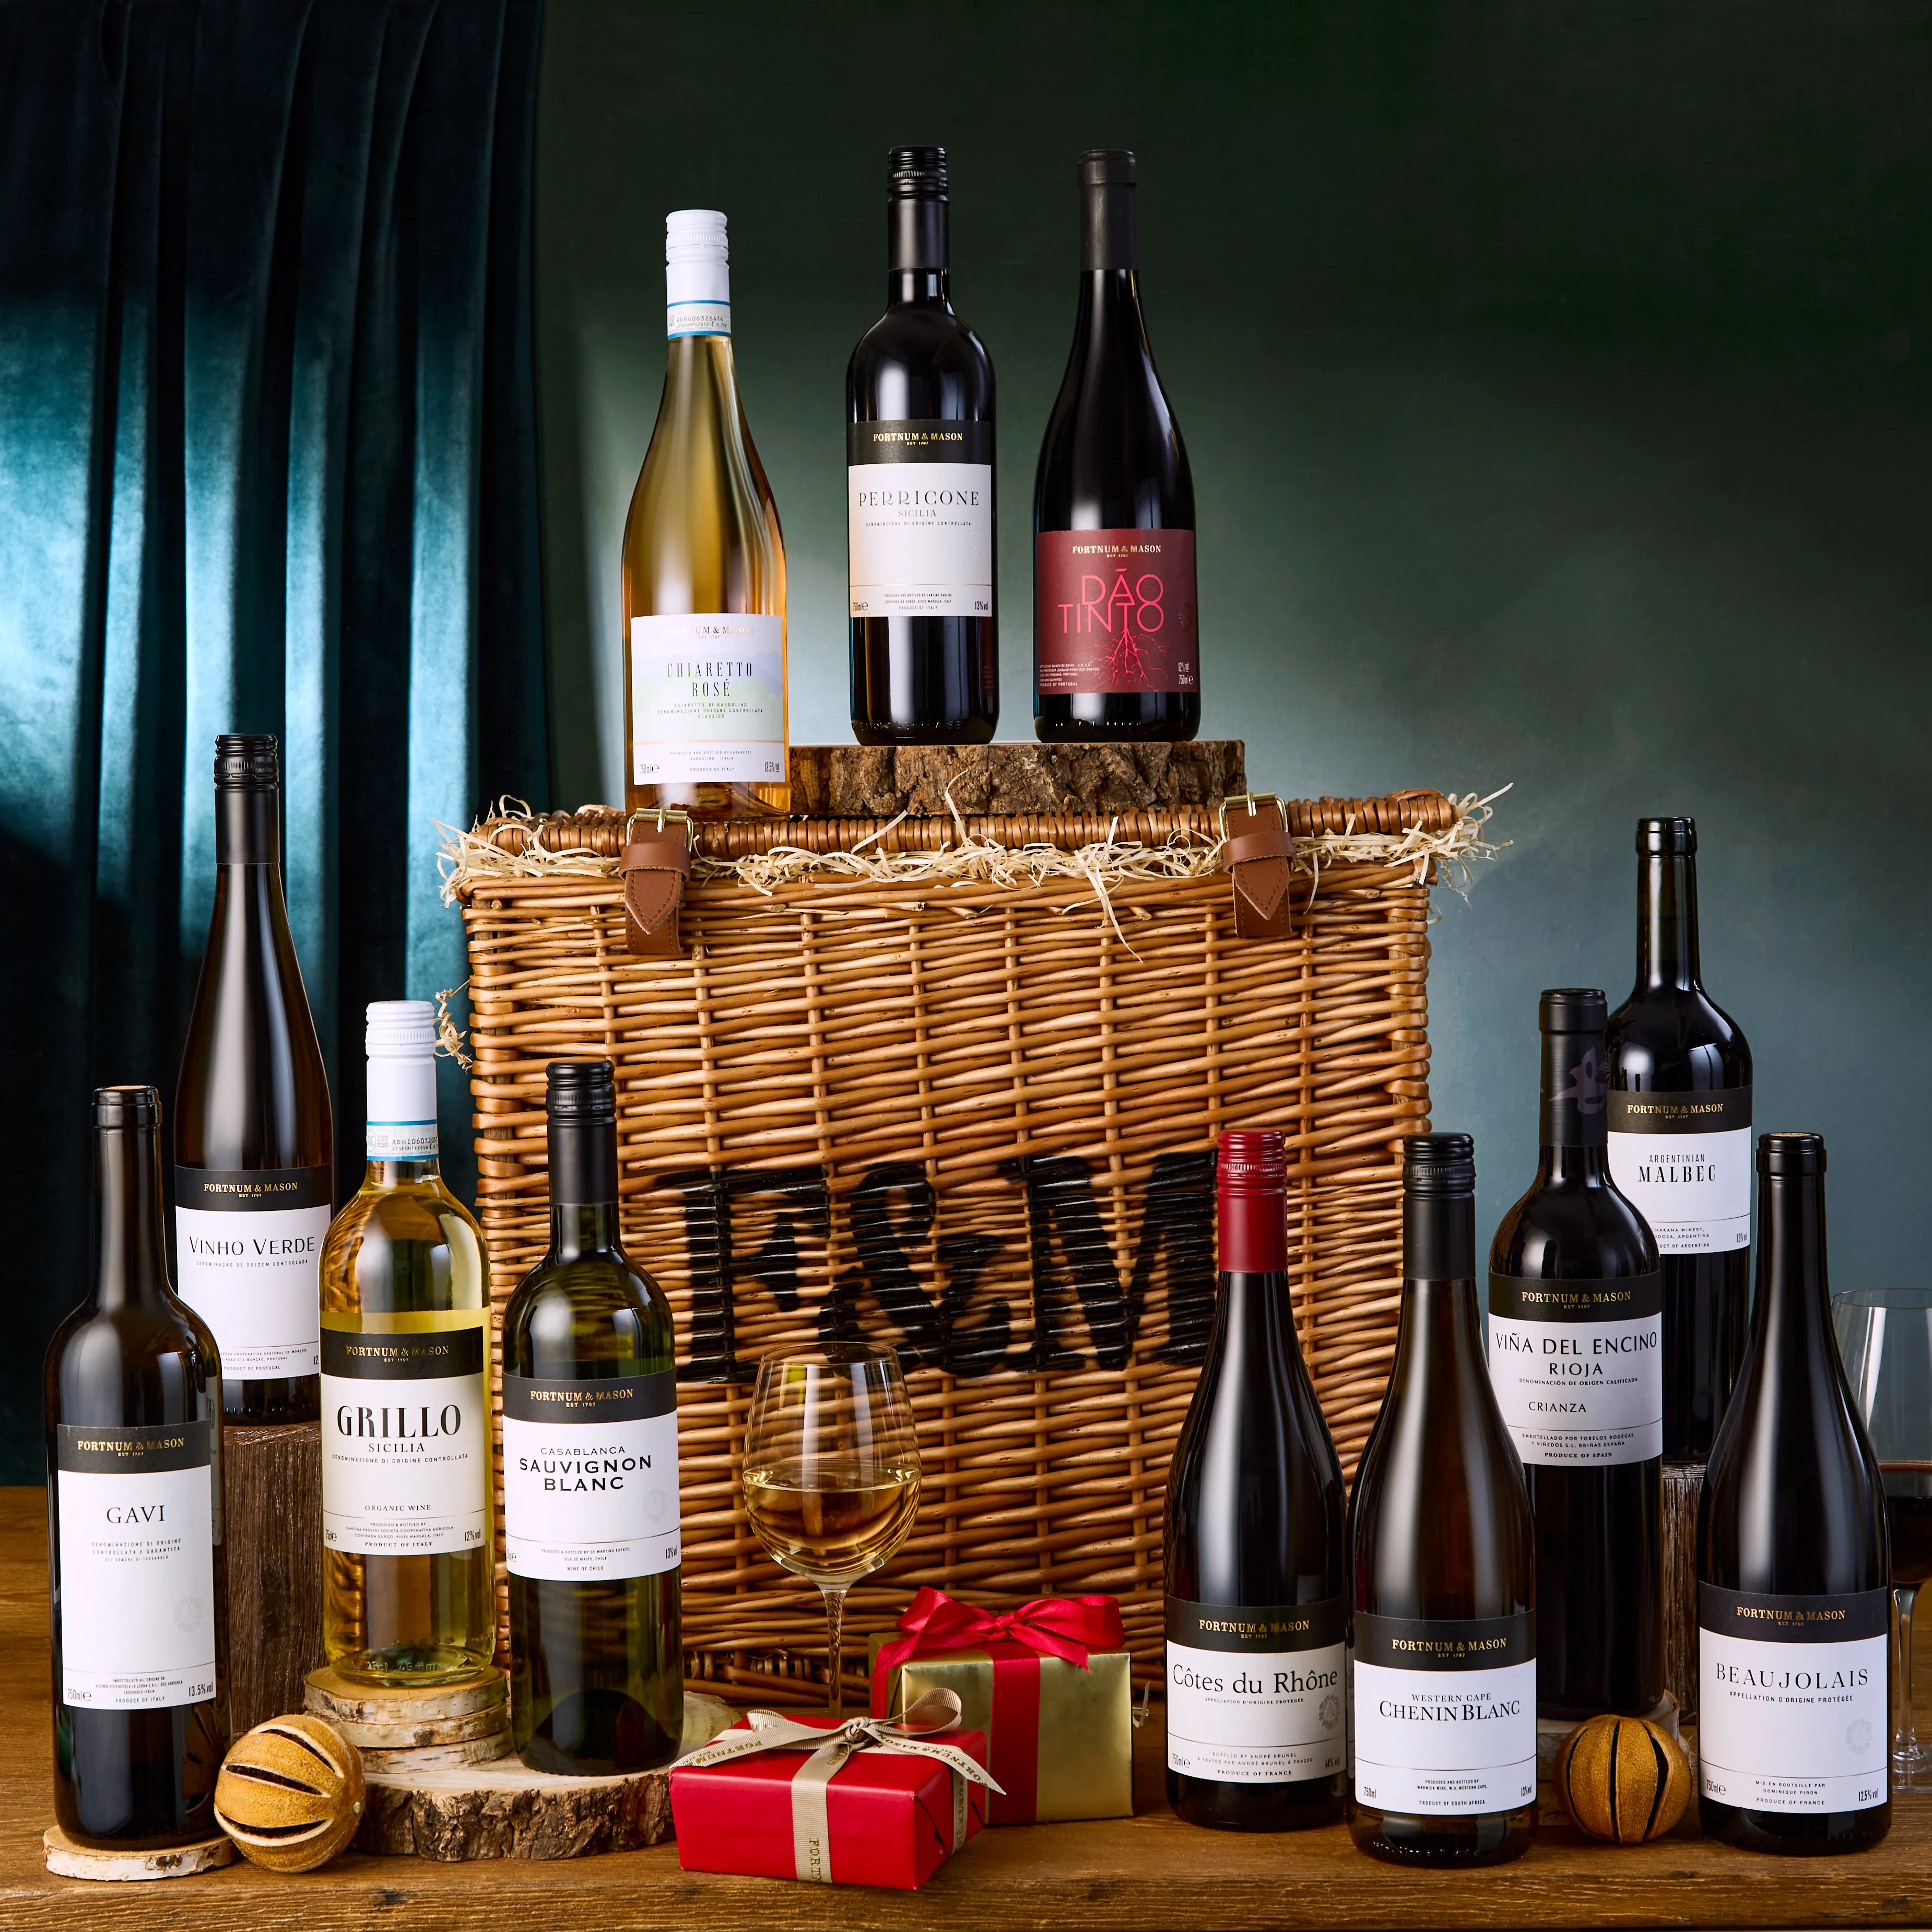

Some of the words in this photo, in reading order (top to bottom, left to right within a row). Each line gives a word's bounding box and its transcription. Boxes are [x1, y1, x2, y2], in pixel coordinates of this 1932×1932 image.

[873, 432, 919, 442] FORTNUM
[931, 432, 963, 441] MASON
[859, 490, 979, 506] PERRICONE
[1072, 545, 1119, 554] FORTNUM
[1081, 568, 1163, 605] DÃO
[1057, 602, 1164, 633] TINTO
[667, 662, 752, 678] CHIARETTO
[692, 679, 730, 697] ROSÉ
[1627, 1104, 1678, 1114] FORTNUM
[1690, 1103, 1724, 1113] MASON
[1649, 1154, 1705, 1163] ARGENTINIAN
[1638, 1164, 1715, 1183] MALBEC
[204, 1183, 252, 1193] FORTNUM
[264, 1182, 298, 1192] MASON
[189, 1236, 244, 1255] VINHO
[253, 1236, 315, 1255] VERDE
[1522, 1291, 1579, 1303] FORTNUM
[1593, 1291, 1631, 1303] MASON
[1496, 1332, 1534, 1353] VIÑA
[1543, 1339, 1582, 1355] DEL
[1593, 1332, 1657, 1354] ENCINO
[346, 1346, 398, 1357] FORTNUM
[400, 1348, 409, 1357] &
[412, 1346, 449, 1356] MASON
[1550, 1362, 1604, 1377] RIOJA
[530, 1391, 582, 1401] FORTNUM
[585, 1393, 593, 1401] &
[595, 1388, 633, 1400] MASON
[1528, 1401, 1587, 1412] CRIANZA
[337, 1405, 461, 1438] GRILLO
[77, 1441, 133, 1452] FORTNUM
[146, 1438, 184, 1450] MASON
[369, 1443, 425, 1453] SICILIA
[540, 1445, 626, 1456] CASABLANCA
[332, 1454, 378, 1464] DENOMINAZIONE
[425, 1453, 468, 1463] CONTROLLATA
[520, 1455, 651, 1474] SAUVIGNON
[544, 1477, 623, 1492] BLANC
[106, 1505, 165, 1524] GAVI
[1737, 1606, 1793, 1620] FORTNUM
[1796, 1611, 1804, 1620] &
[1807, 1610, 1845, 1621] MASON
[1199, 1620, 1256, 1633] FORTNUM
[1258, 1623, 1267, 1633] &
[1270, 1620, 1310, 1632] MASON
[1392, 1639, 1453, 1652] FORTNUM
[1456, 1642, 1465, 1651] &
[1468, 1638, 1507, 1651] MASON
[1173, 1664, 1223, 1692] Côtes
[1233, 1672, 1263, 1694] du
[1274, 1670, 1337, 1693] Rhône
[1716, 1662, 1868, 1689] BEAUJOLAIS
[1411, 1693, 1462, 1702] WESTERN
[1466, 1693, 1491, 1702] CAPE
[1729, 1691, 1775, 1702] APPELLATION
[1818, 1694, 1854, 1703] PROTÉGÉE
[1380, 1700, 1457, 1721] CHENIN
[1462, 1700, 1520, 1721] BLANC
